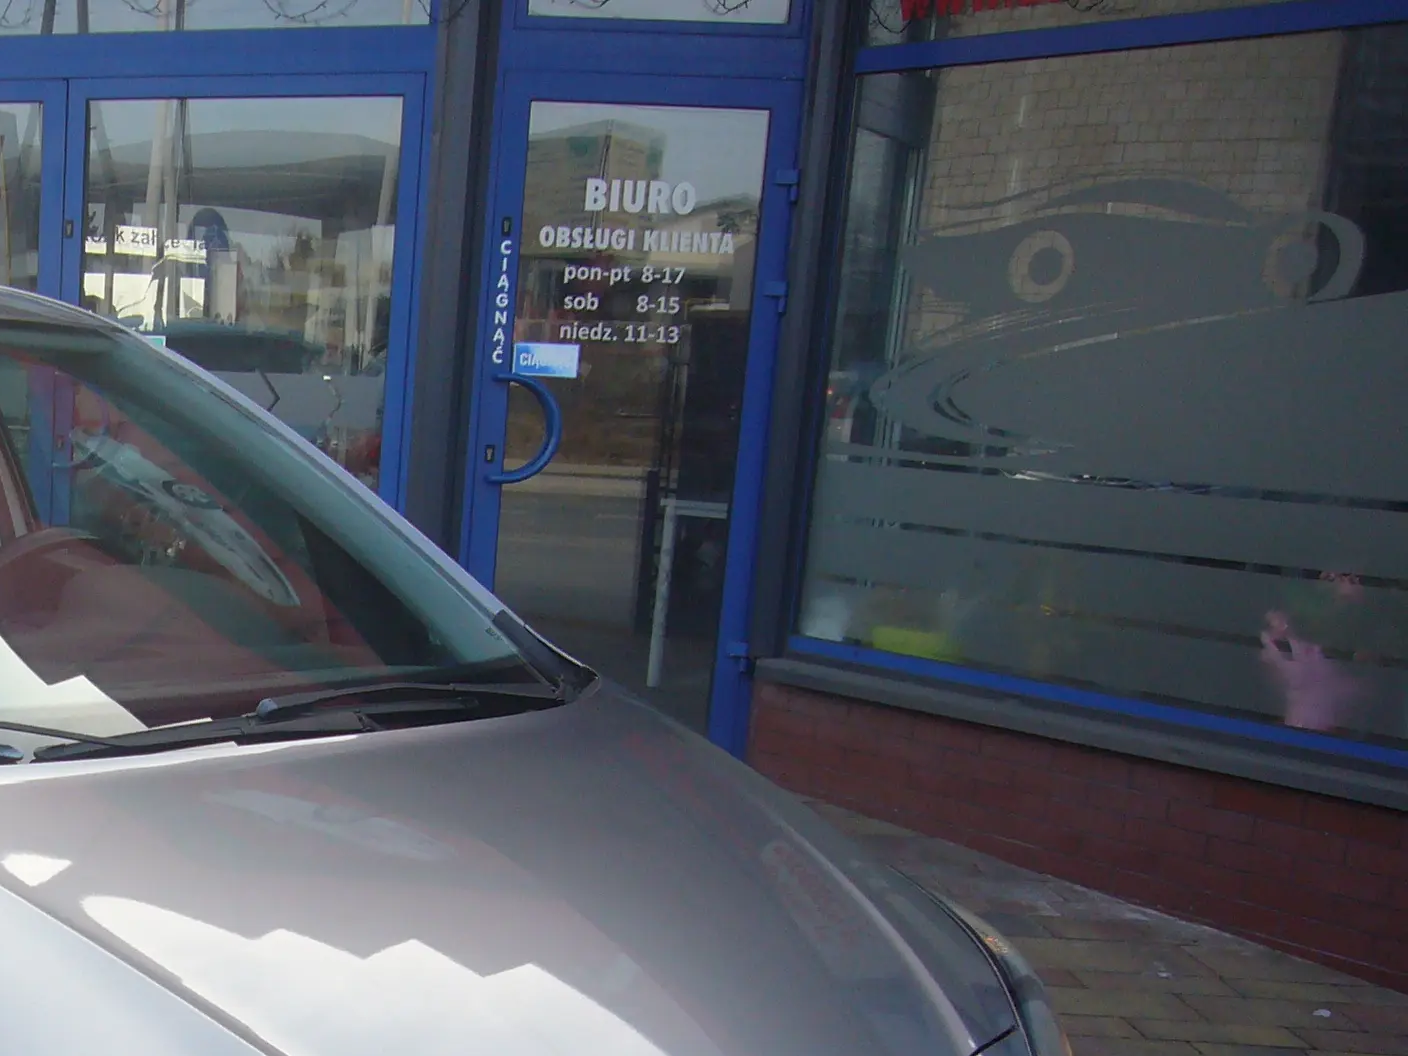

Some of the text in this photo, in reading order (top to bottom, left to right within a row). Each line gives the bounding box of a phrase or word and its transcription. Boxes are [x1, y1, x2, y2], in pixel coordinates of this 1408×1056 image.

[584, 178, 696, 215] BIURO
[539, 225, 734, 254] OBSŁUGI KLIENTA
[563, 264, 686, 286] pon-pt 8-17
[492, 240, 512, 364] CIĄGNĄĆ
[564, 292, 680, 314] sob 8-15
[560, 322, 680, 343] niedz. 11-13
